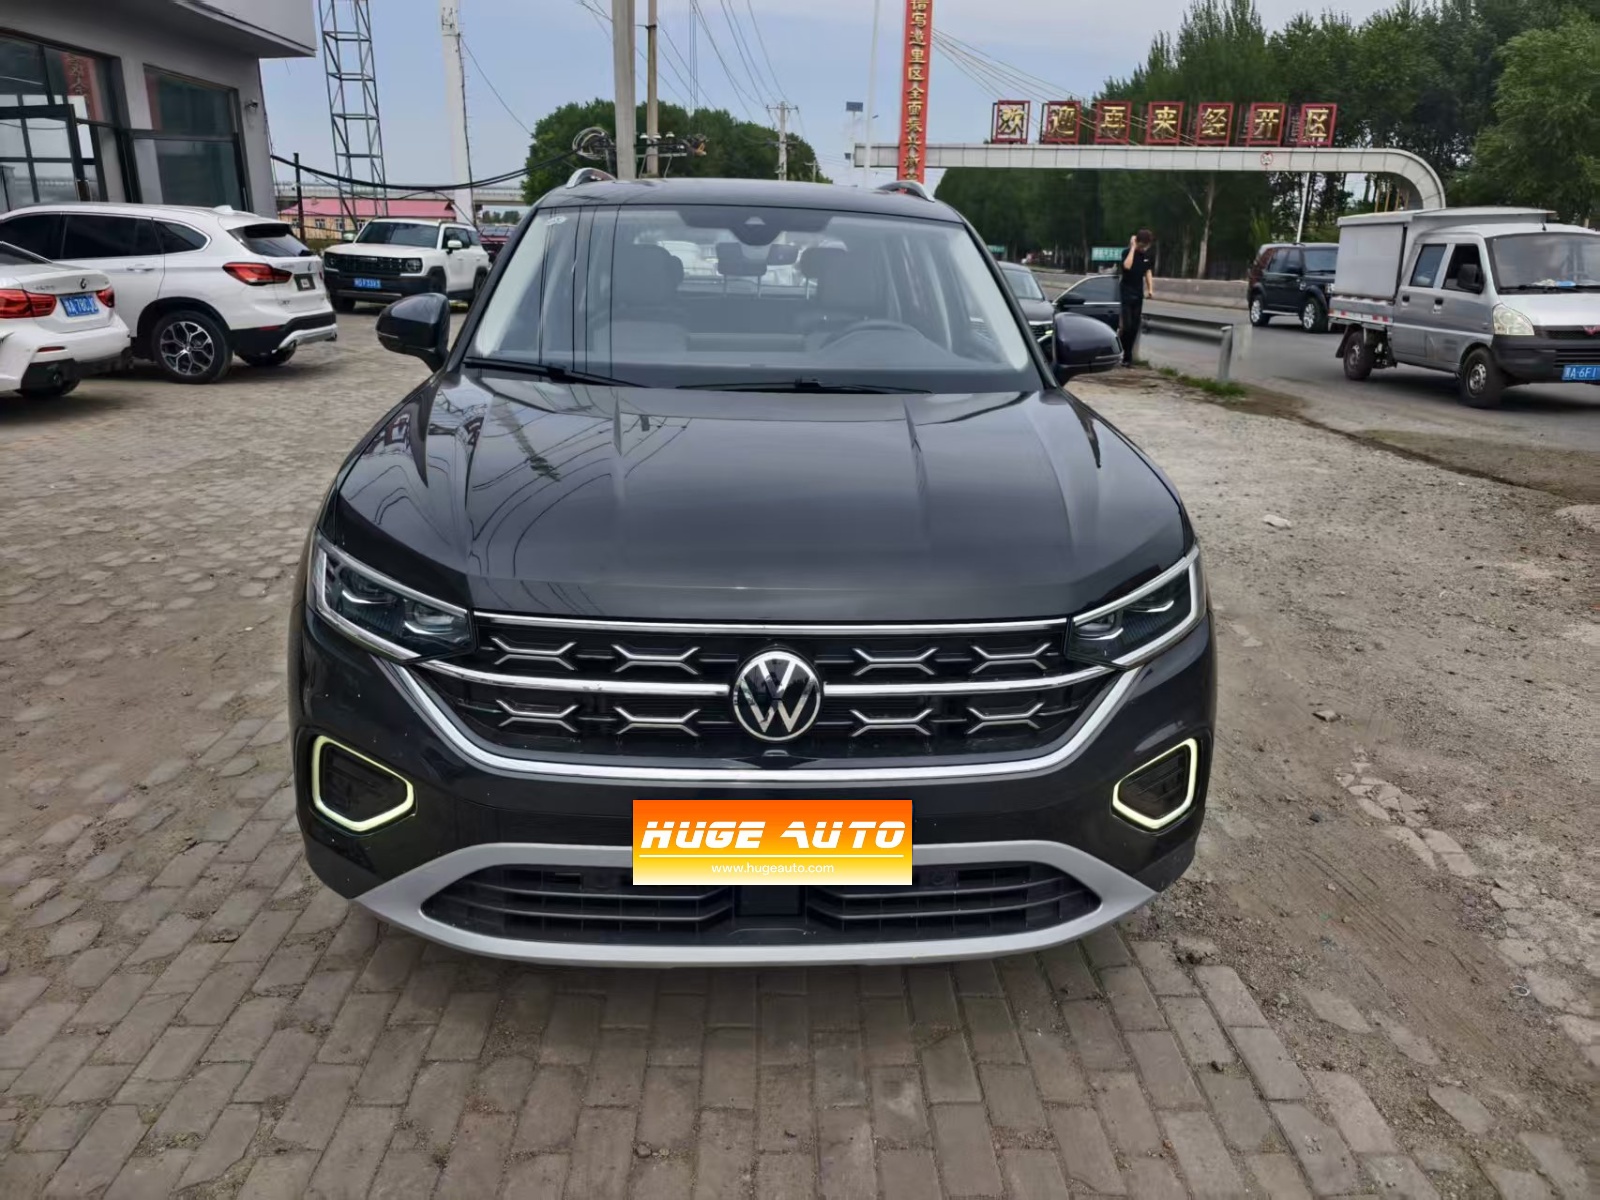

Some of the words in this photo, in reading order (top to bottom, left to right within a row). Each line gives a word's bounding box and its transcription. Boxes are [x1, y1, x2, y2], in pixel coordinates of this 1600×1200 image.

[999, 105, 1330, 138] 欢迎再来经开区
